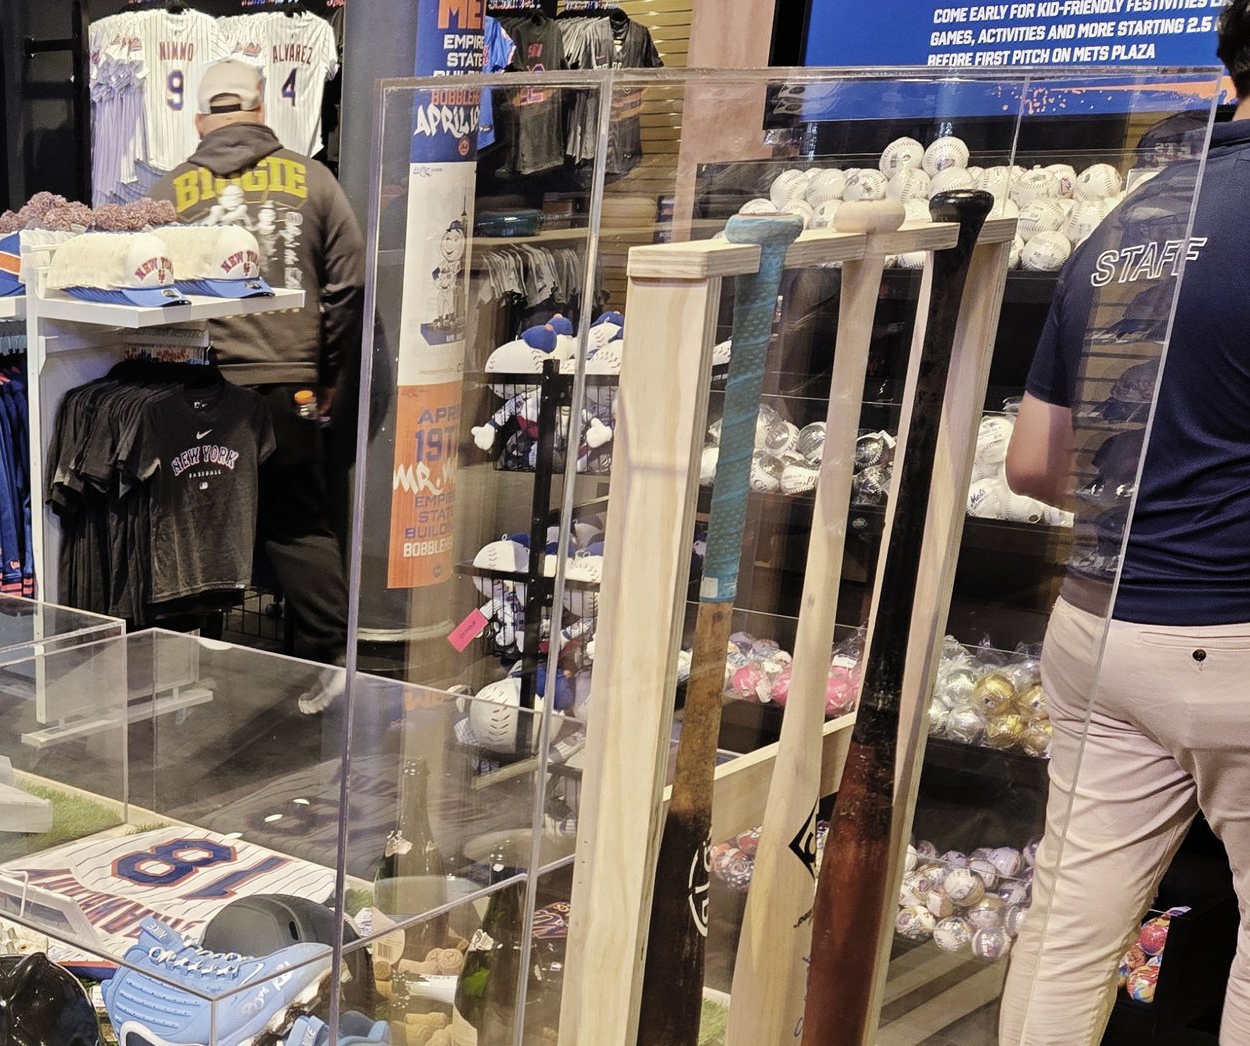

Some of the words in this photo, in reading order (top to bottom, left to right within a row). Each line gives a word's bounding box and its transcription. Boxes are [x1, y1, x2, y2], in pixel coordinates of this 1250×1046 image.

[933, 8, 968, 23] COME
[970, 5, 1008, 21] EARLY
[1009, 3, 1035, 19] FOR
[1037, 0, 1124, 17] KID-FRIENDLY
[930, 30, 976, 46] GAMES,
[978, 26, 1046, 43] ACTIVITIES
[1047, 23, 1076, 39] AND
[1077, 21, 1116, 38] MORE
[1117, 18, 1185, 36] STARTING
[1186, 16, 1213, 33] 2.5
[159, 41, 194, 62] NIMMO
[272, 44, 314, 65] ALVAREZ
[927, 52, 973, 66] BEFORE
[974, 50, 1011, 66] FIRST
[1012, 48, 1051, 64] PITCH
[1052, 47, 1071, 63] ON
[1073, 45, 1109, 62] METS
[1111, 43, 1155, 60] PLAZA
[166, 69, 184, 111] 9
[281, 68, 297, 106] 4
[414, 104, 469, 138] APRIL
[135, 257, 158, 281] NEW
[160, 256, 174, 280] YOR
[221, 251, 244, 273] NEW
[246, 250, 260, 271] YOR
[1090, 237, 1208, 287] STAFF
[171, 447, 200, 476] NEW
[202, 445, 239, 470] YORK
[189, 470, 221, 479] BASEBALL
[393, 460, 443, 495] MR.
[111, 838, 292, 900] 18
